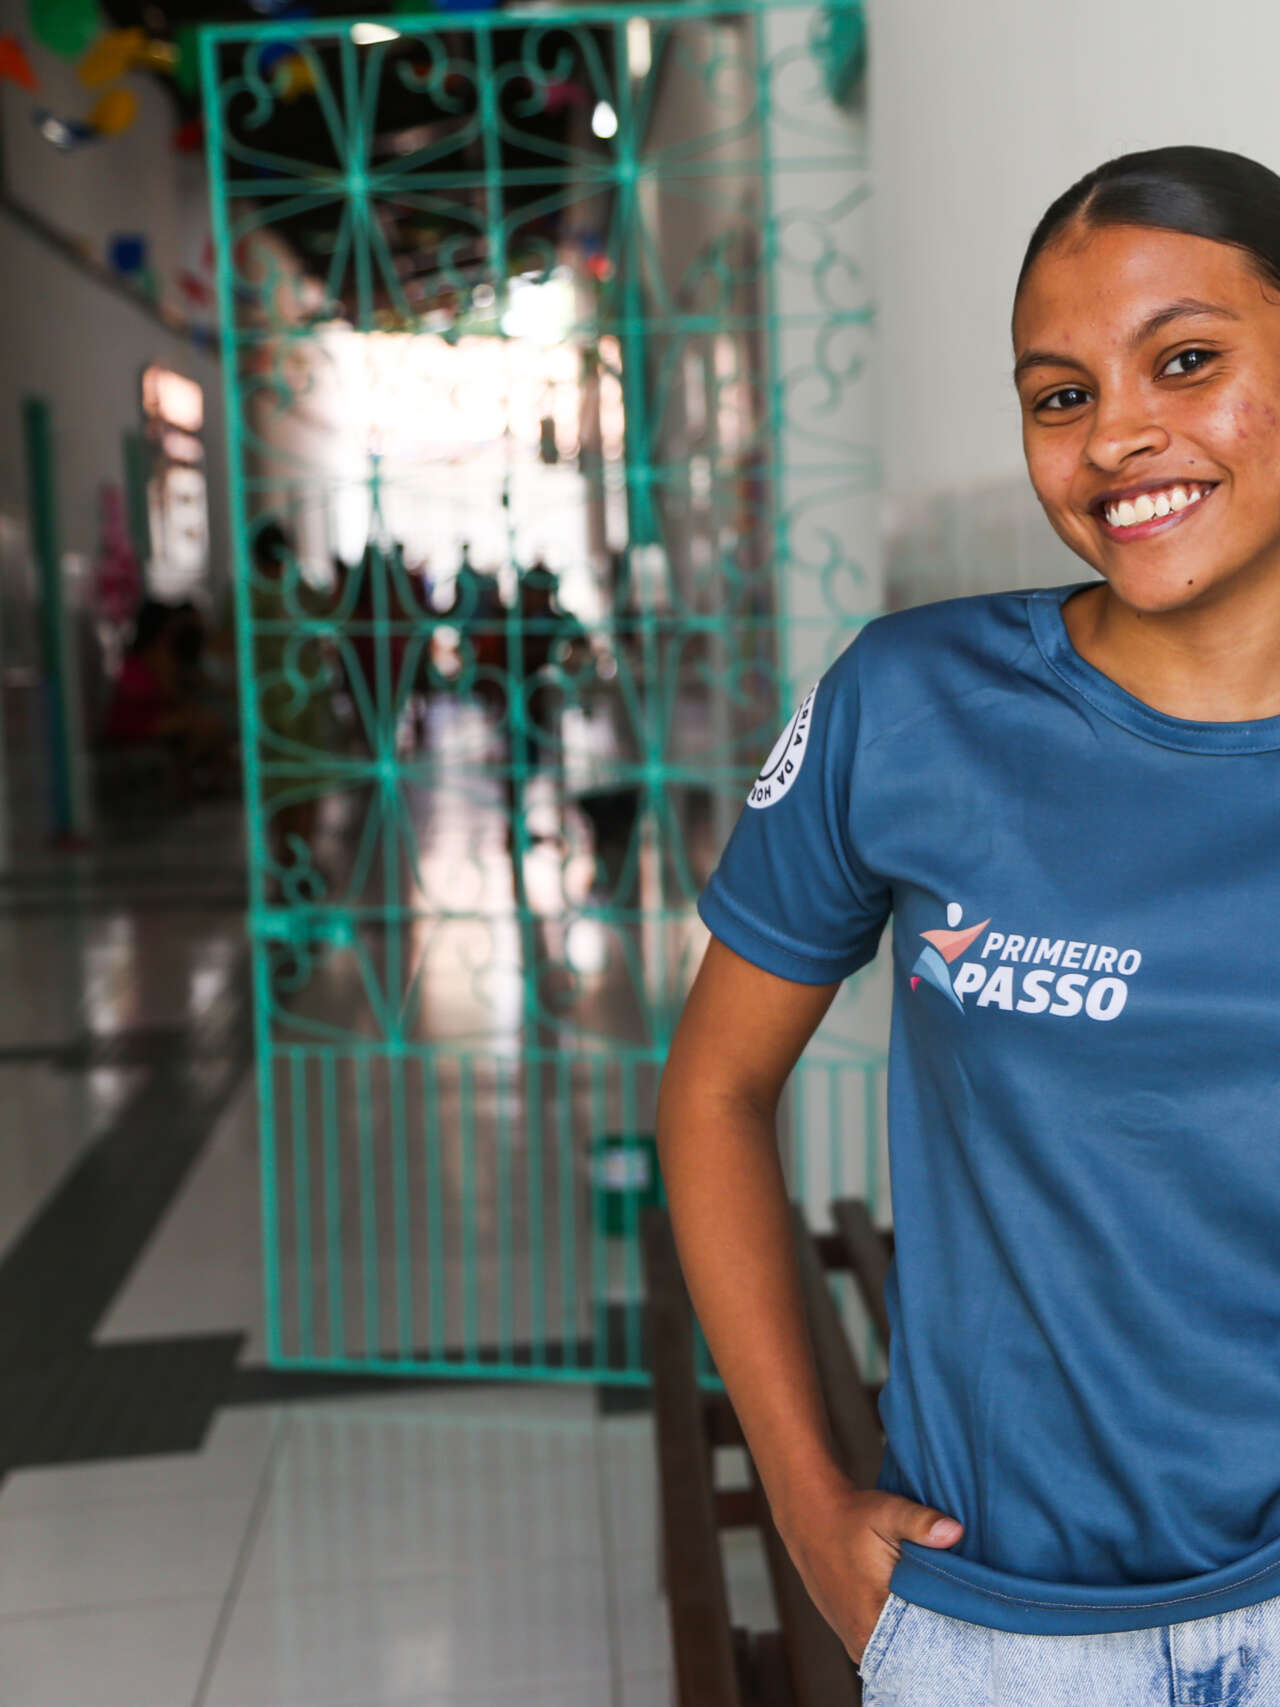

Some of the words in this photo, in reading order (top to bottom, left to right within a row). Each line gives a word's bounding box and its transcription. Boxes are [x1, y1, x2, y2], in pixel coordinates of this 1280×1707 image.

[777, 759, 794, 785] DA
[980, 932, 1142, 976] PRIMEIRO
[953, 962, 1129, 1022] PASSO
